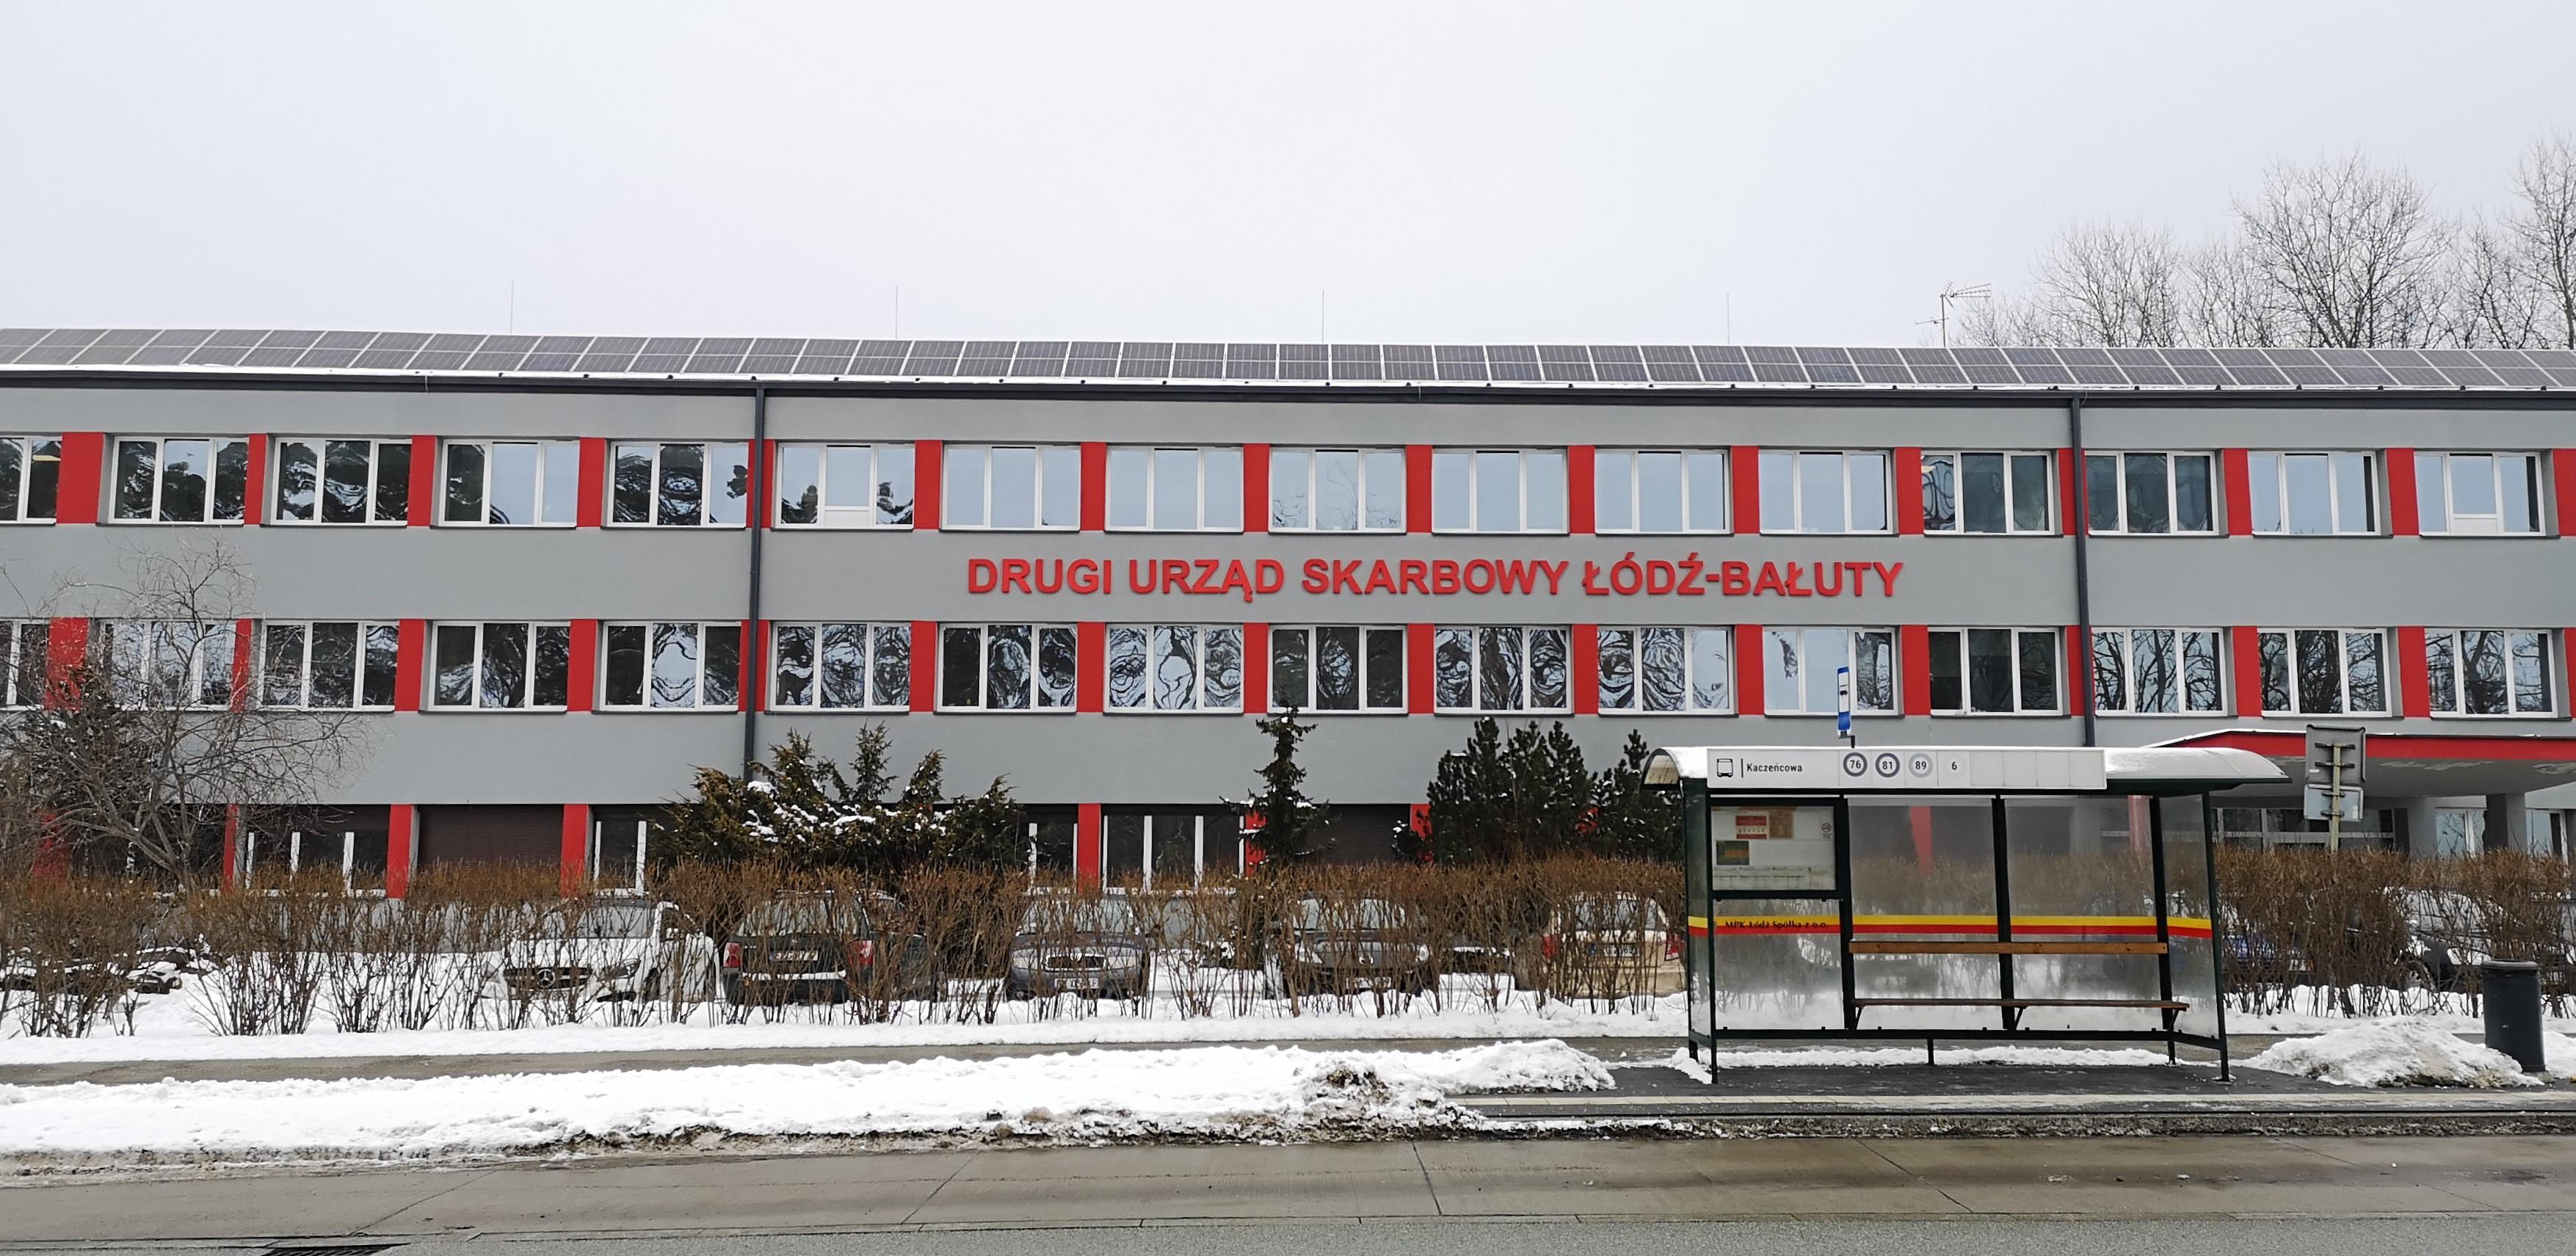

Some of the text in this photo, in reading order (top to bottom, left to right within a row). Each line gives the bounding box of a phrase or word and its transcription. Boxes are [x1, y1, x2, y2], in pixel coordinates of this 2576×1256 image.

[968, 551, 1904, 603] DRUGI URZĄD SKARBOWY ŁÓDŹ-BAŁUTY
[1746, 760, 1958, 772] Kaczeńcowa 76 81 89 6
